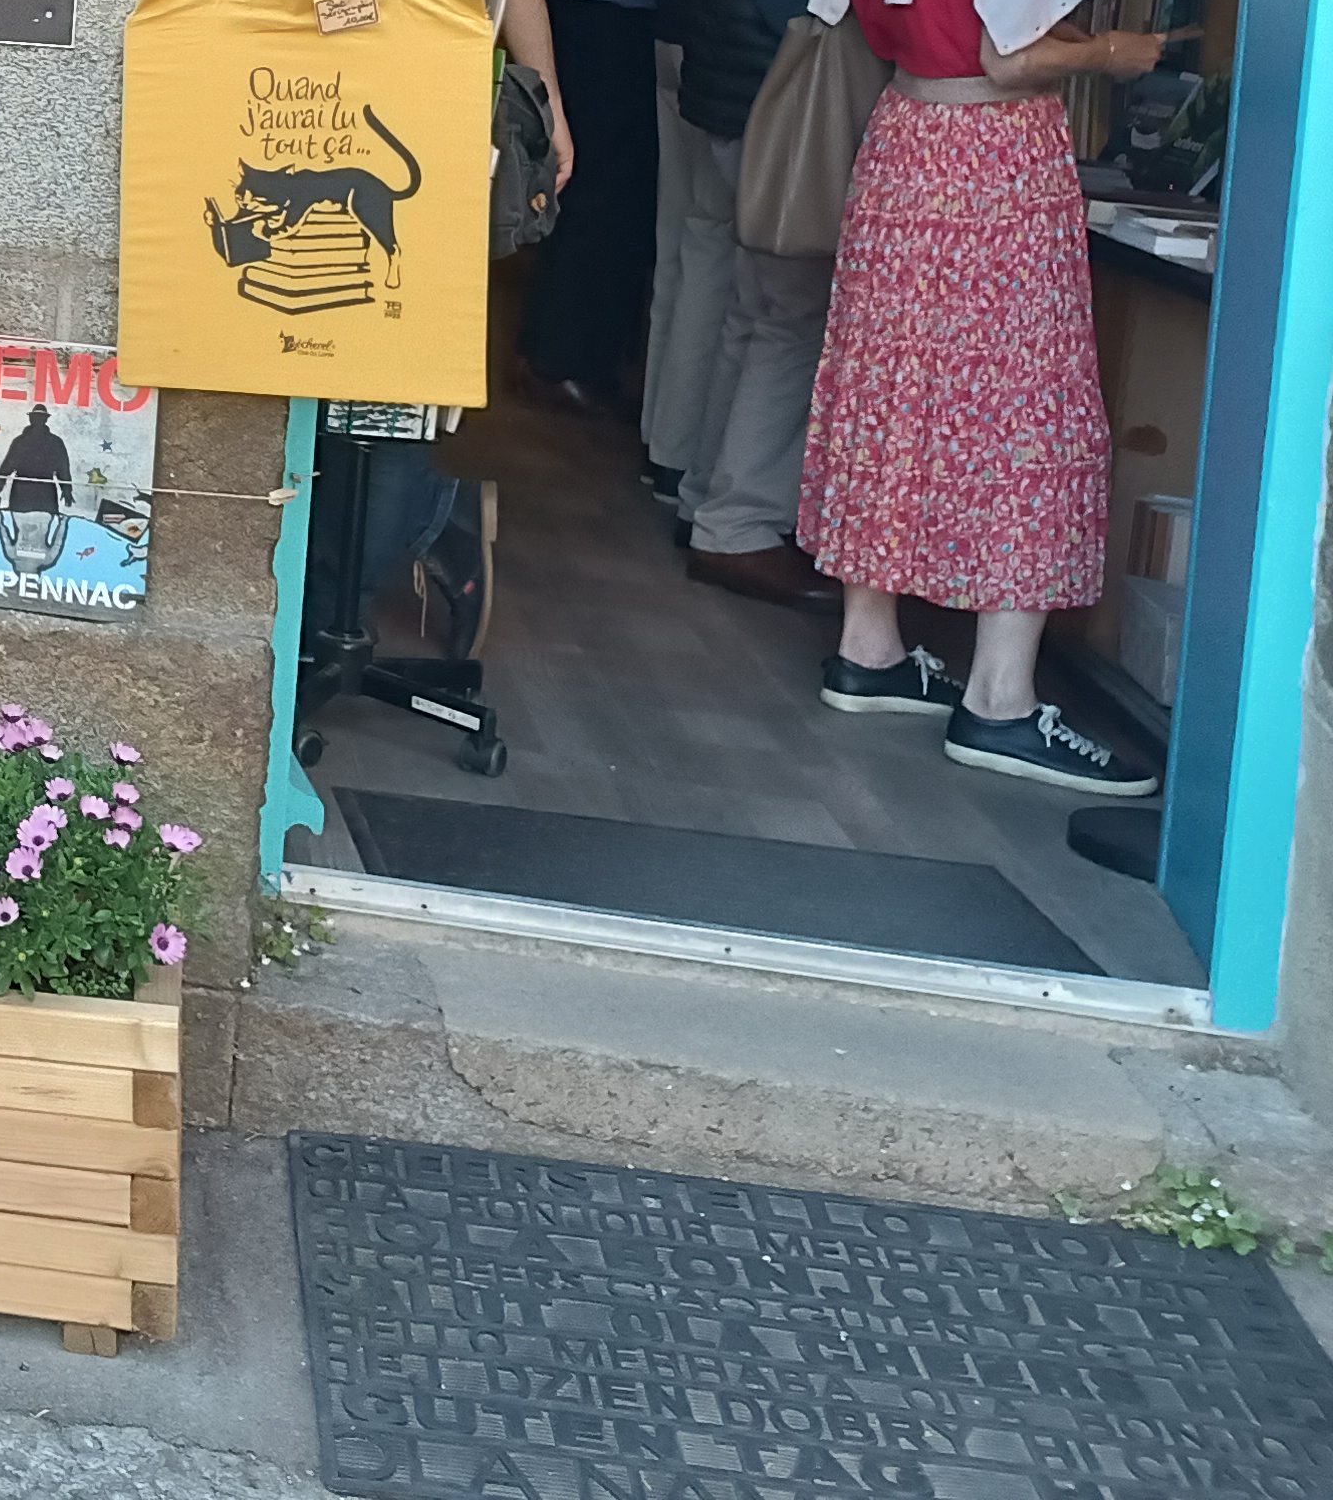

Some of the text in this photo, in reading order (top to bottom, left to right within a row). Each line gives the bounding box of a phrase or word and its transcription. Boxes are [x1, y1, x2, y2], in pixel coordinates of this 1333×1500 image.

[248, 66, 342, 102] Quand
[239, 100, 358, 137] j'aurai lu
[260, 133, 319, 161] tout
